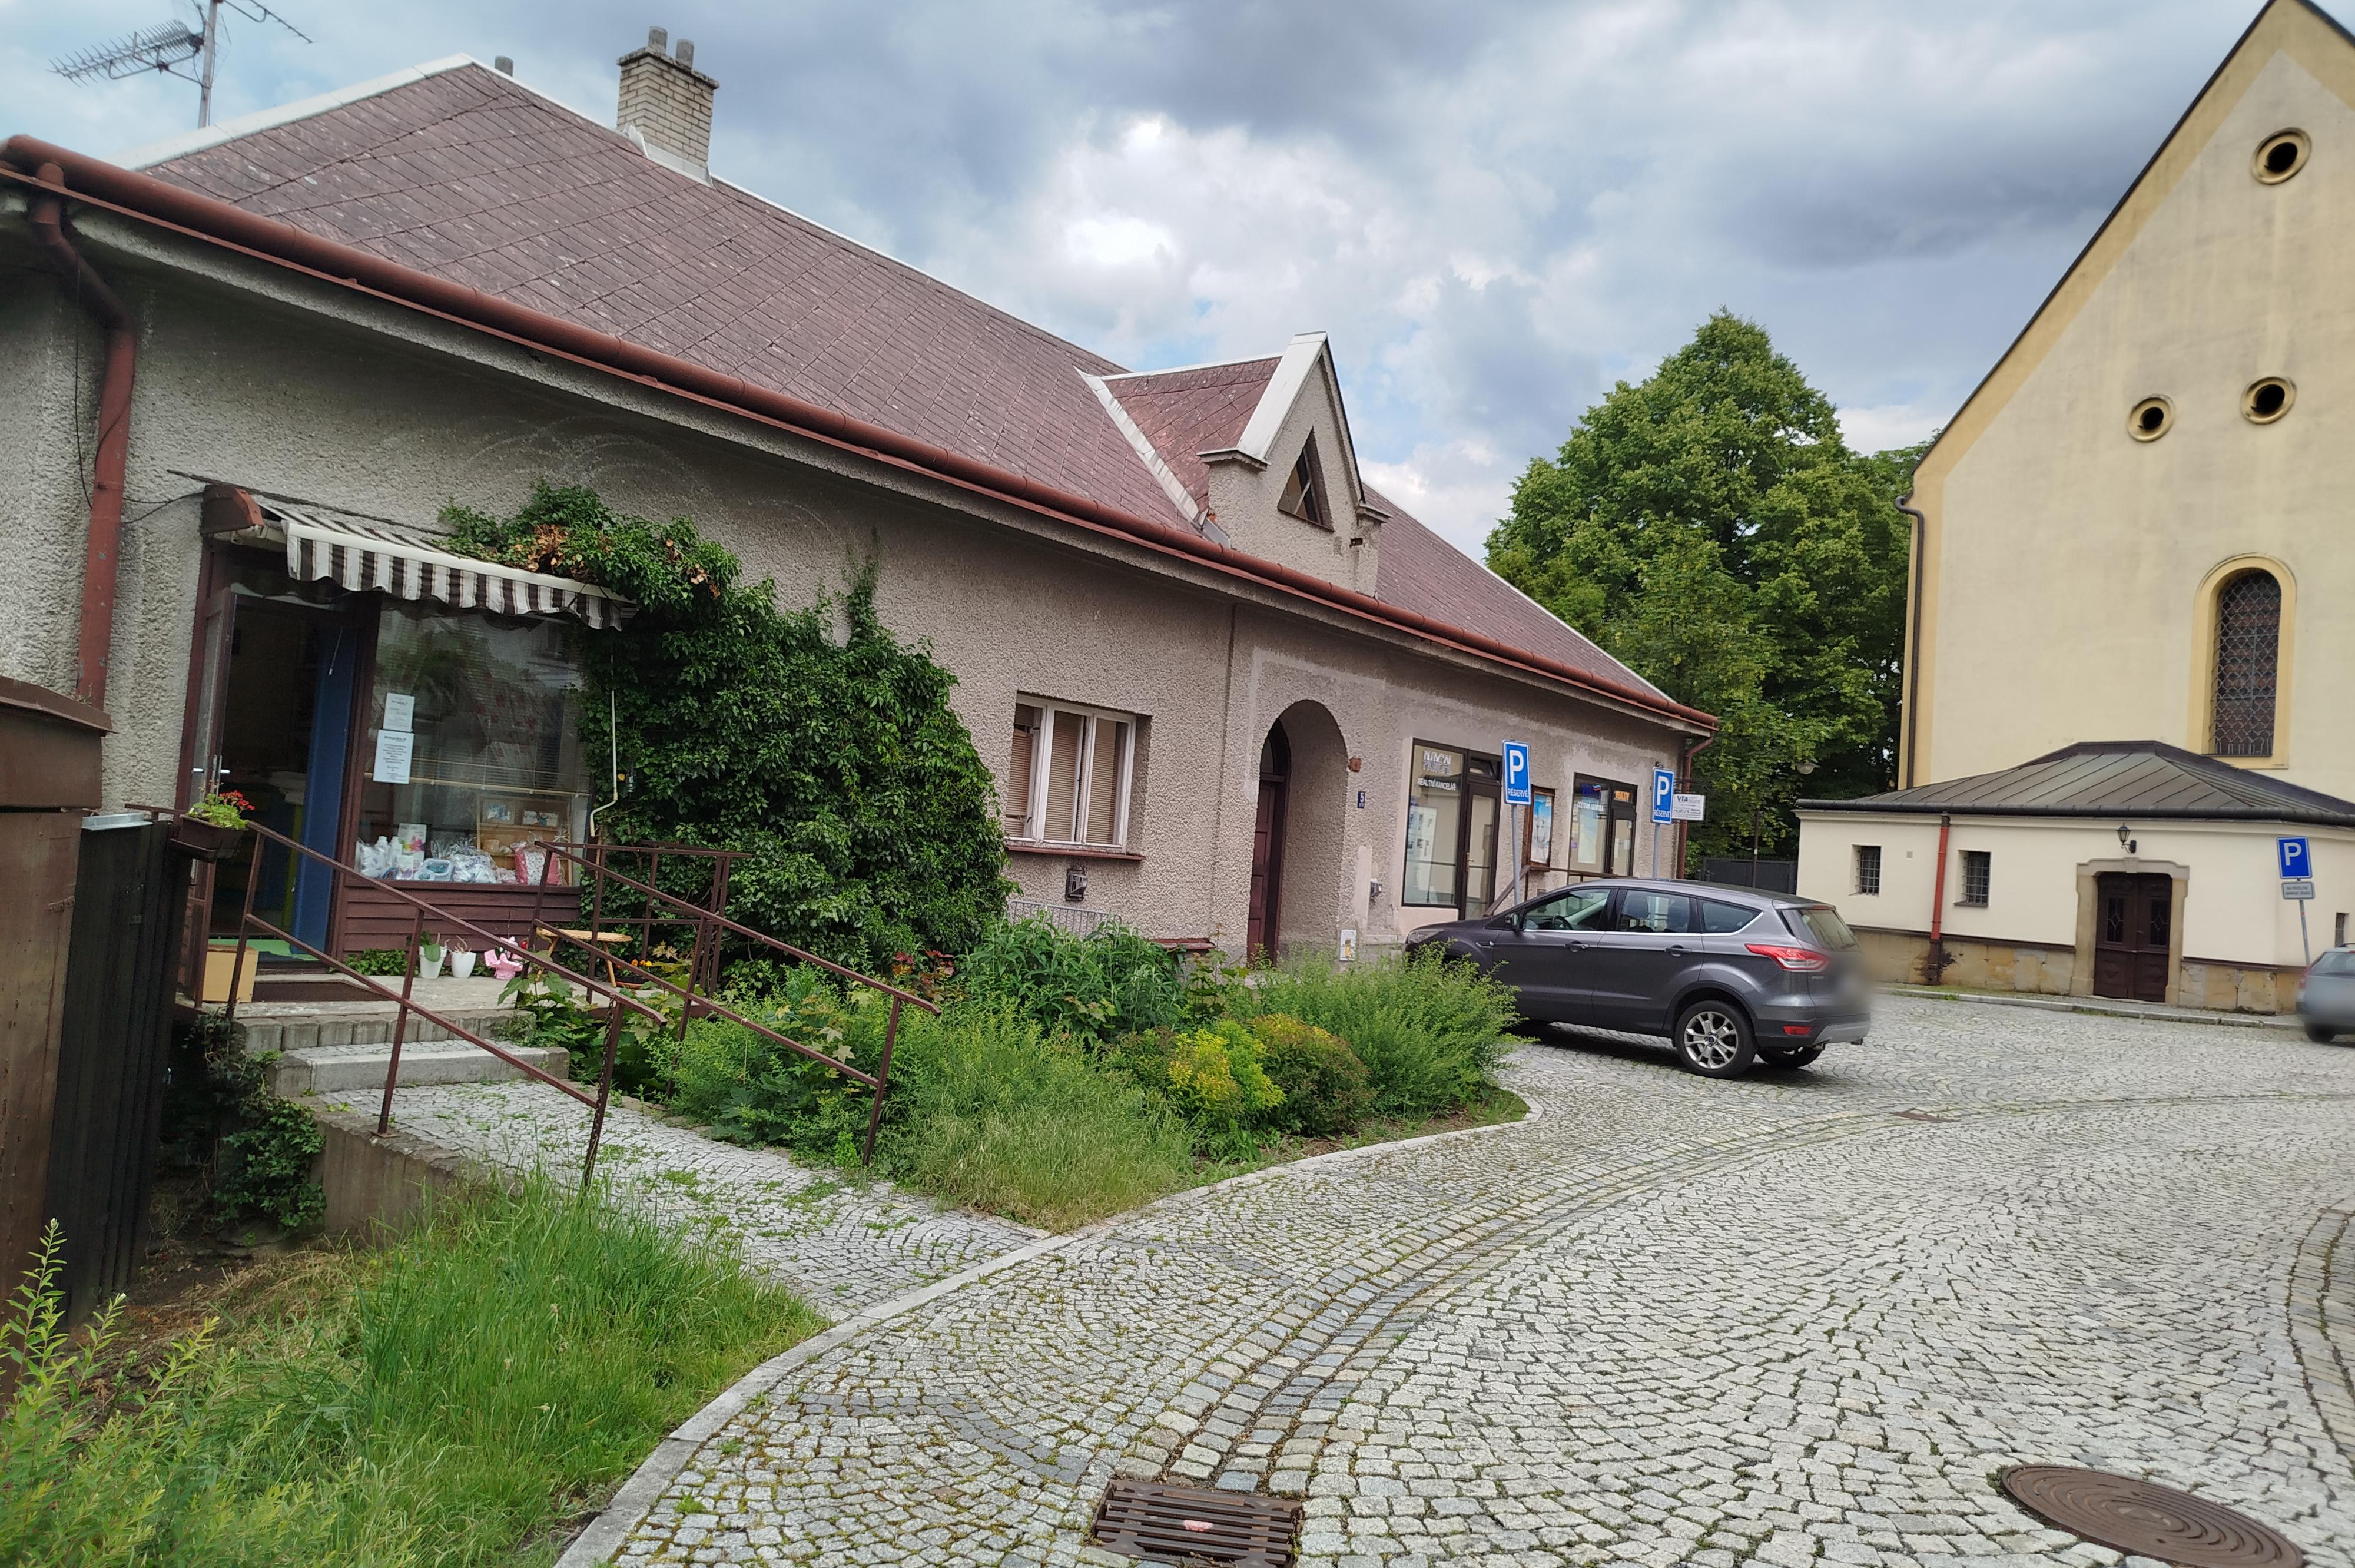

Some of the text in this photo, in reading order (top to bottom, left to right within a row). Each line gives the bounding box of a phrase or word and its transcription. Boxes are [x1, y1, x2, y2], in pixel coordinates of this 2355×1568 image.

[1509, 749, 1524, 784] P
[1417, 777, 1436, 787] REALITNÍ
[1507, 787, 1529, 798] RÉSERVÉ
[1656, 775, 1670, 806] P
[2284, 842, 2302, 866] P
